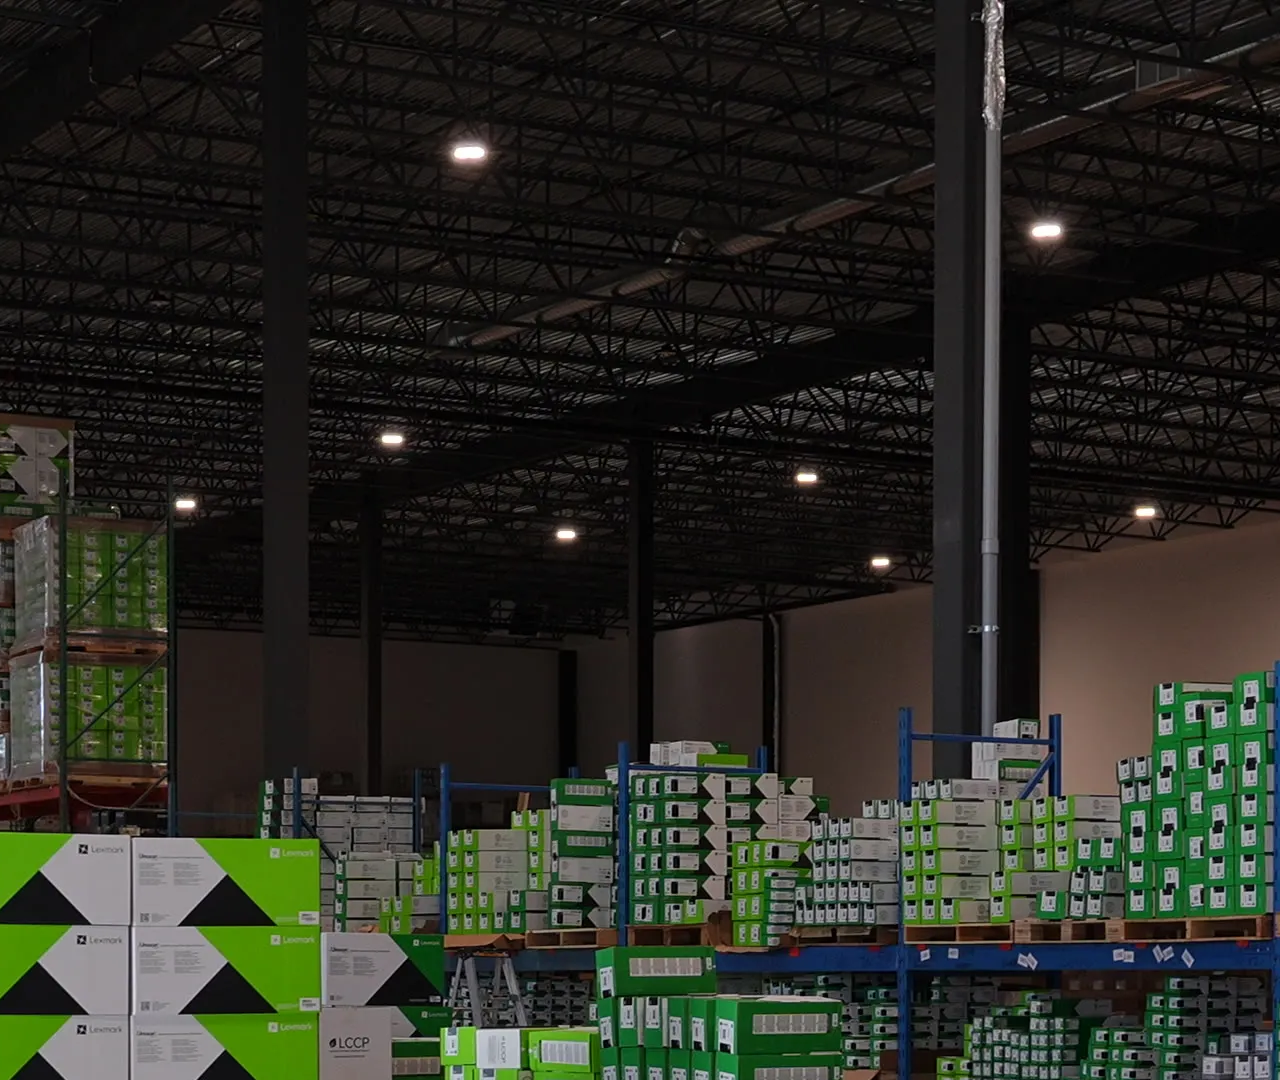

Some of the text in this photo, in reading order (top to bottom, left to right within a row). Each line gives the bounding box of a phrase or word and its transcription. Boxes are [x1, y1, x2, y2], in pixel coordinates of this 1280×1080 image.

[91, 846, 124, 854] Lexmark
[89, 936, 123, 944] Lexmark
[89, 1025, 122, 1033] Lexmark
[338, 1037, 370, 1049] LCCP
